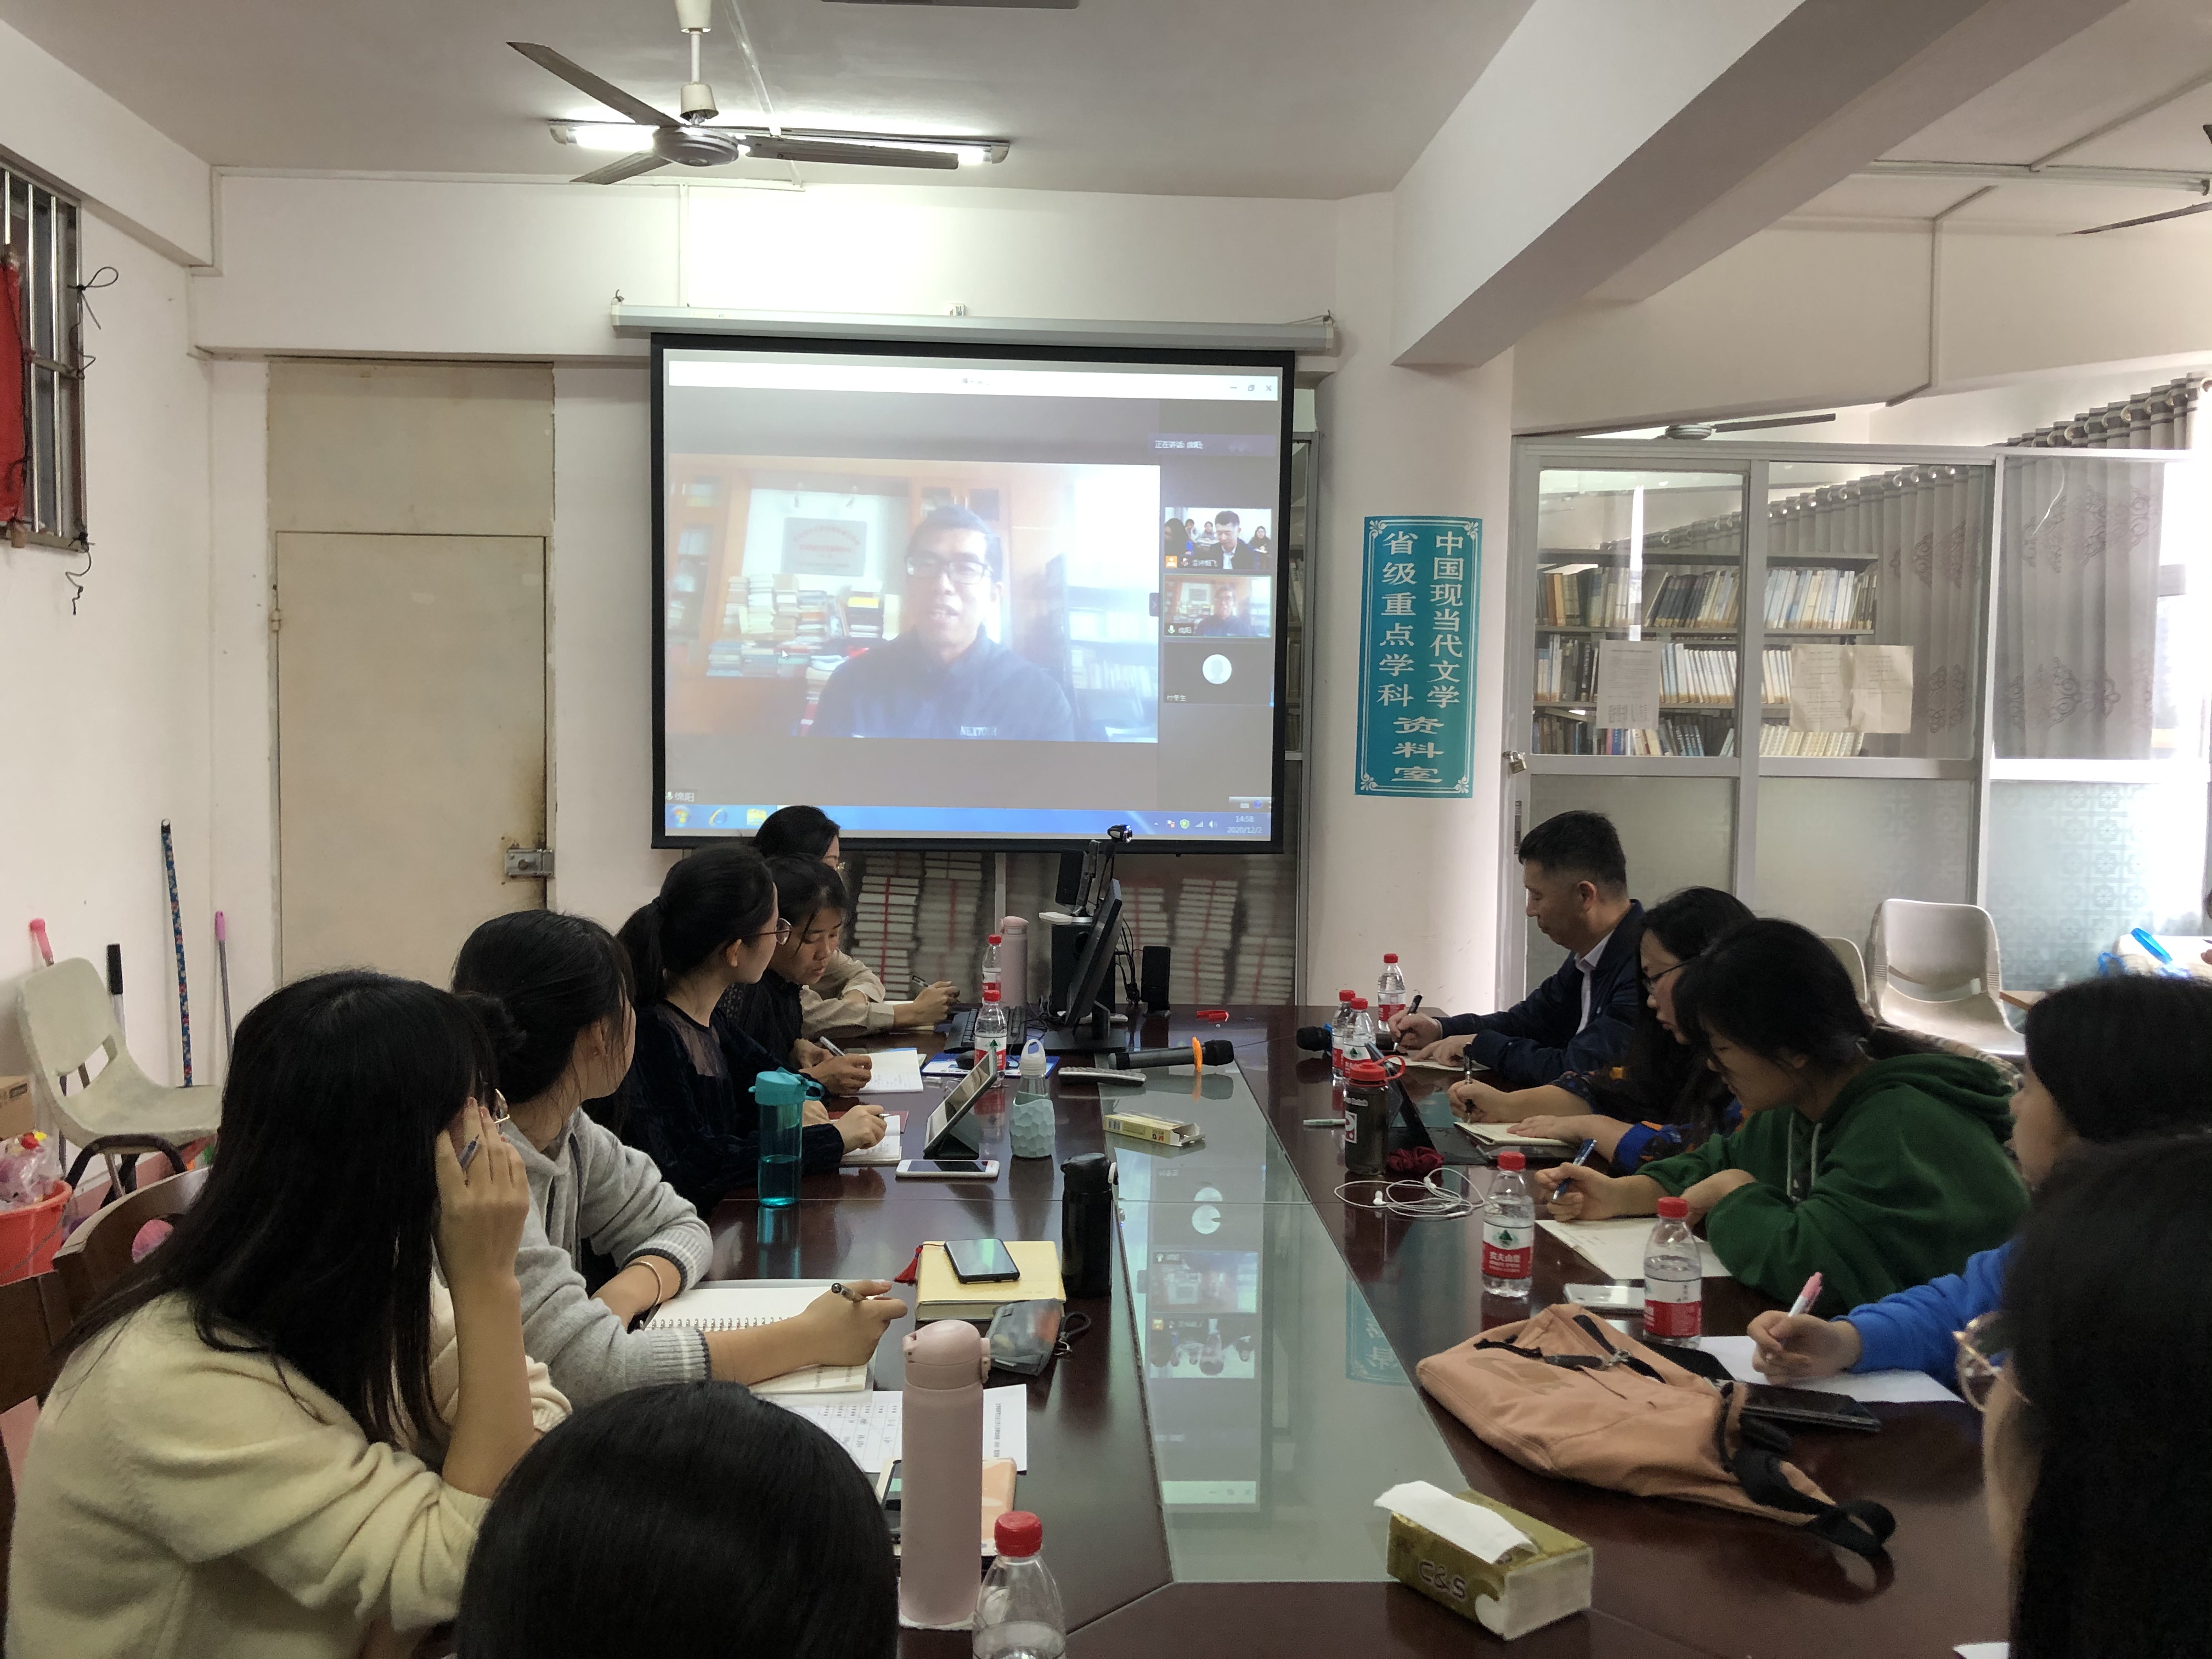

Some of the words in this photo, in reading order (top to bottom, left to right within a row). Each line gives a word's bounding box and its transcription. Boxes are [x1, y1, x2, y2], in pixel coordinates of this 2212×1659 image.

[1376, 531, 1419, 707] 省级重点学科
[1426, 531, 1464, 708] 中国现当代文学
[1390, 715, 1444, 783] 资料室
